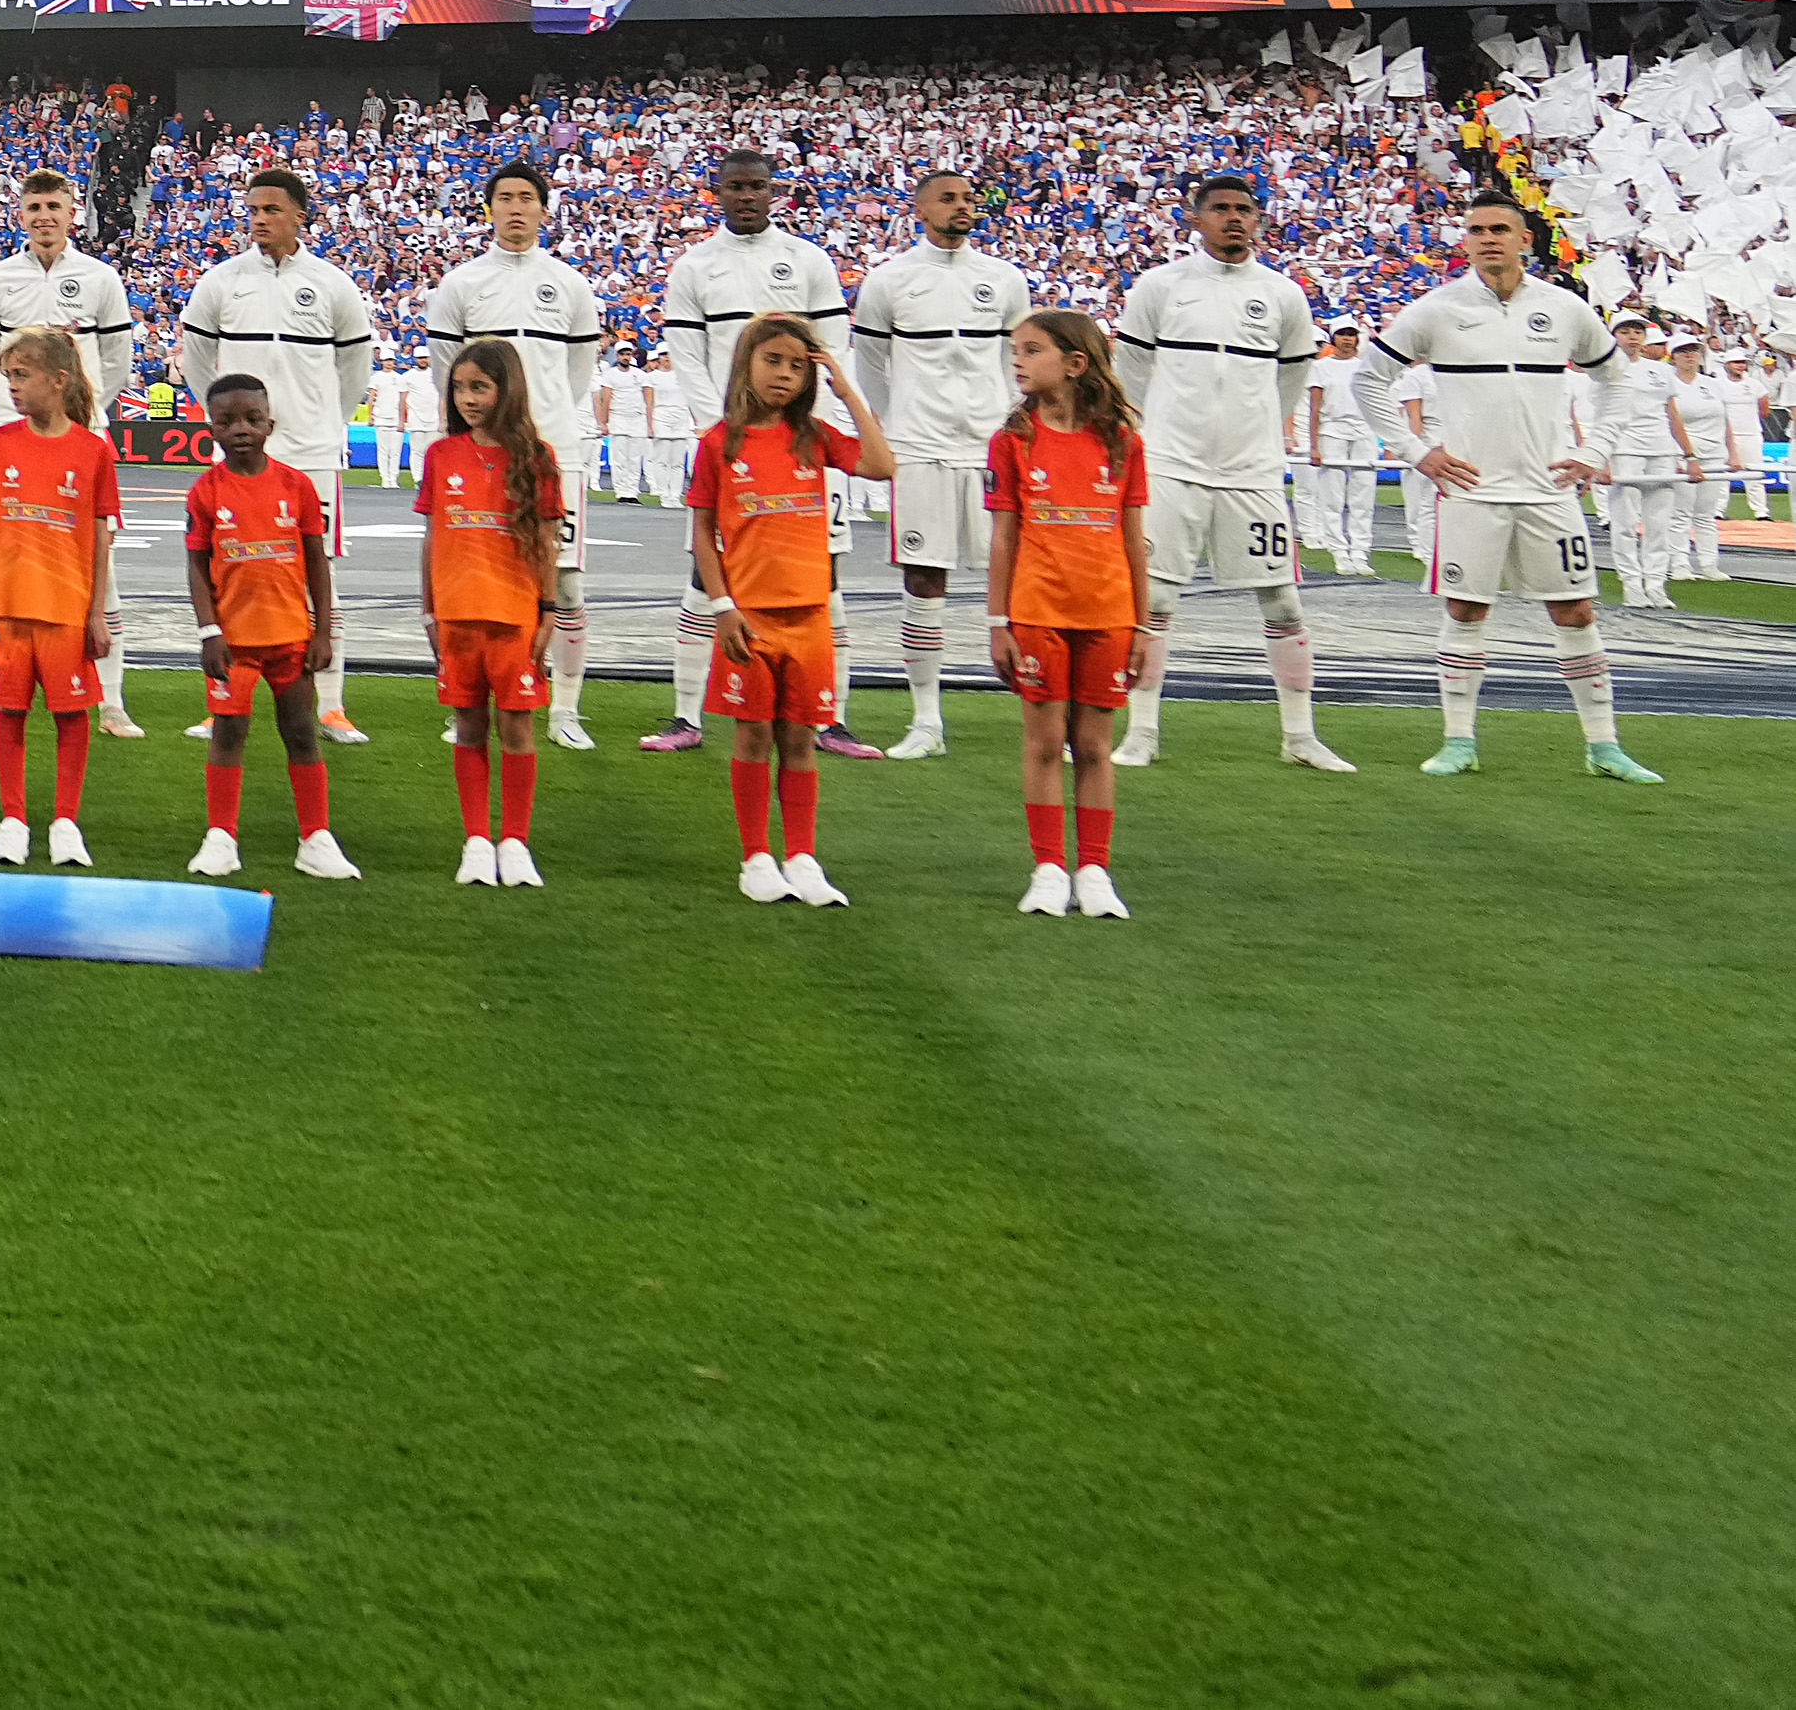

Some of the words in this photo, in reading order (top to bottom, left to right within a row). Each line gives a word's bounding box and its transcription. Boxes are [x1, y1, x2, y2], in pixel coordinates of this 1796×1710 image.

[832, 493, 845, 527] 2
[1249, 522, 1287, 557] 36
[1556, 535, 1588, 572] 19
